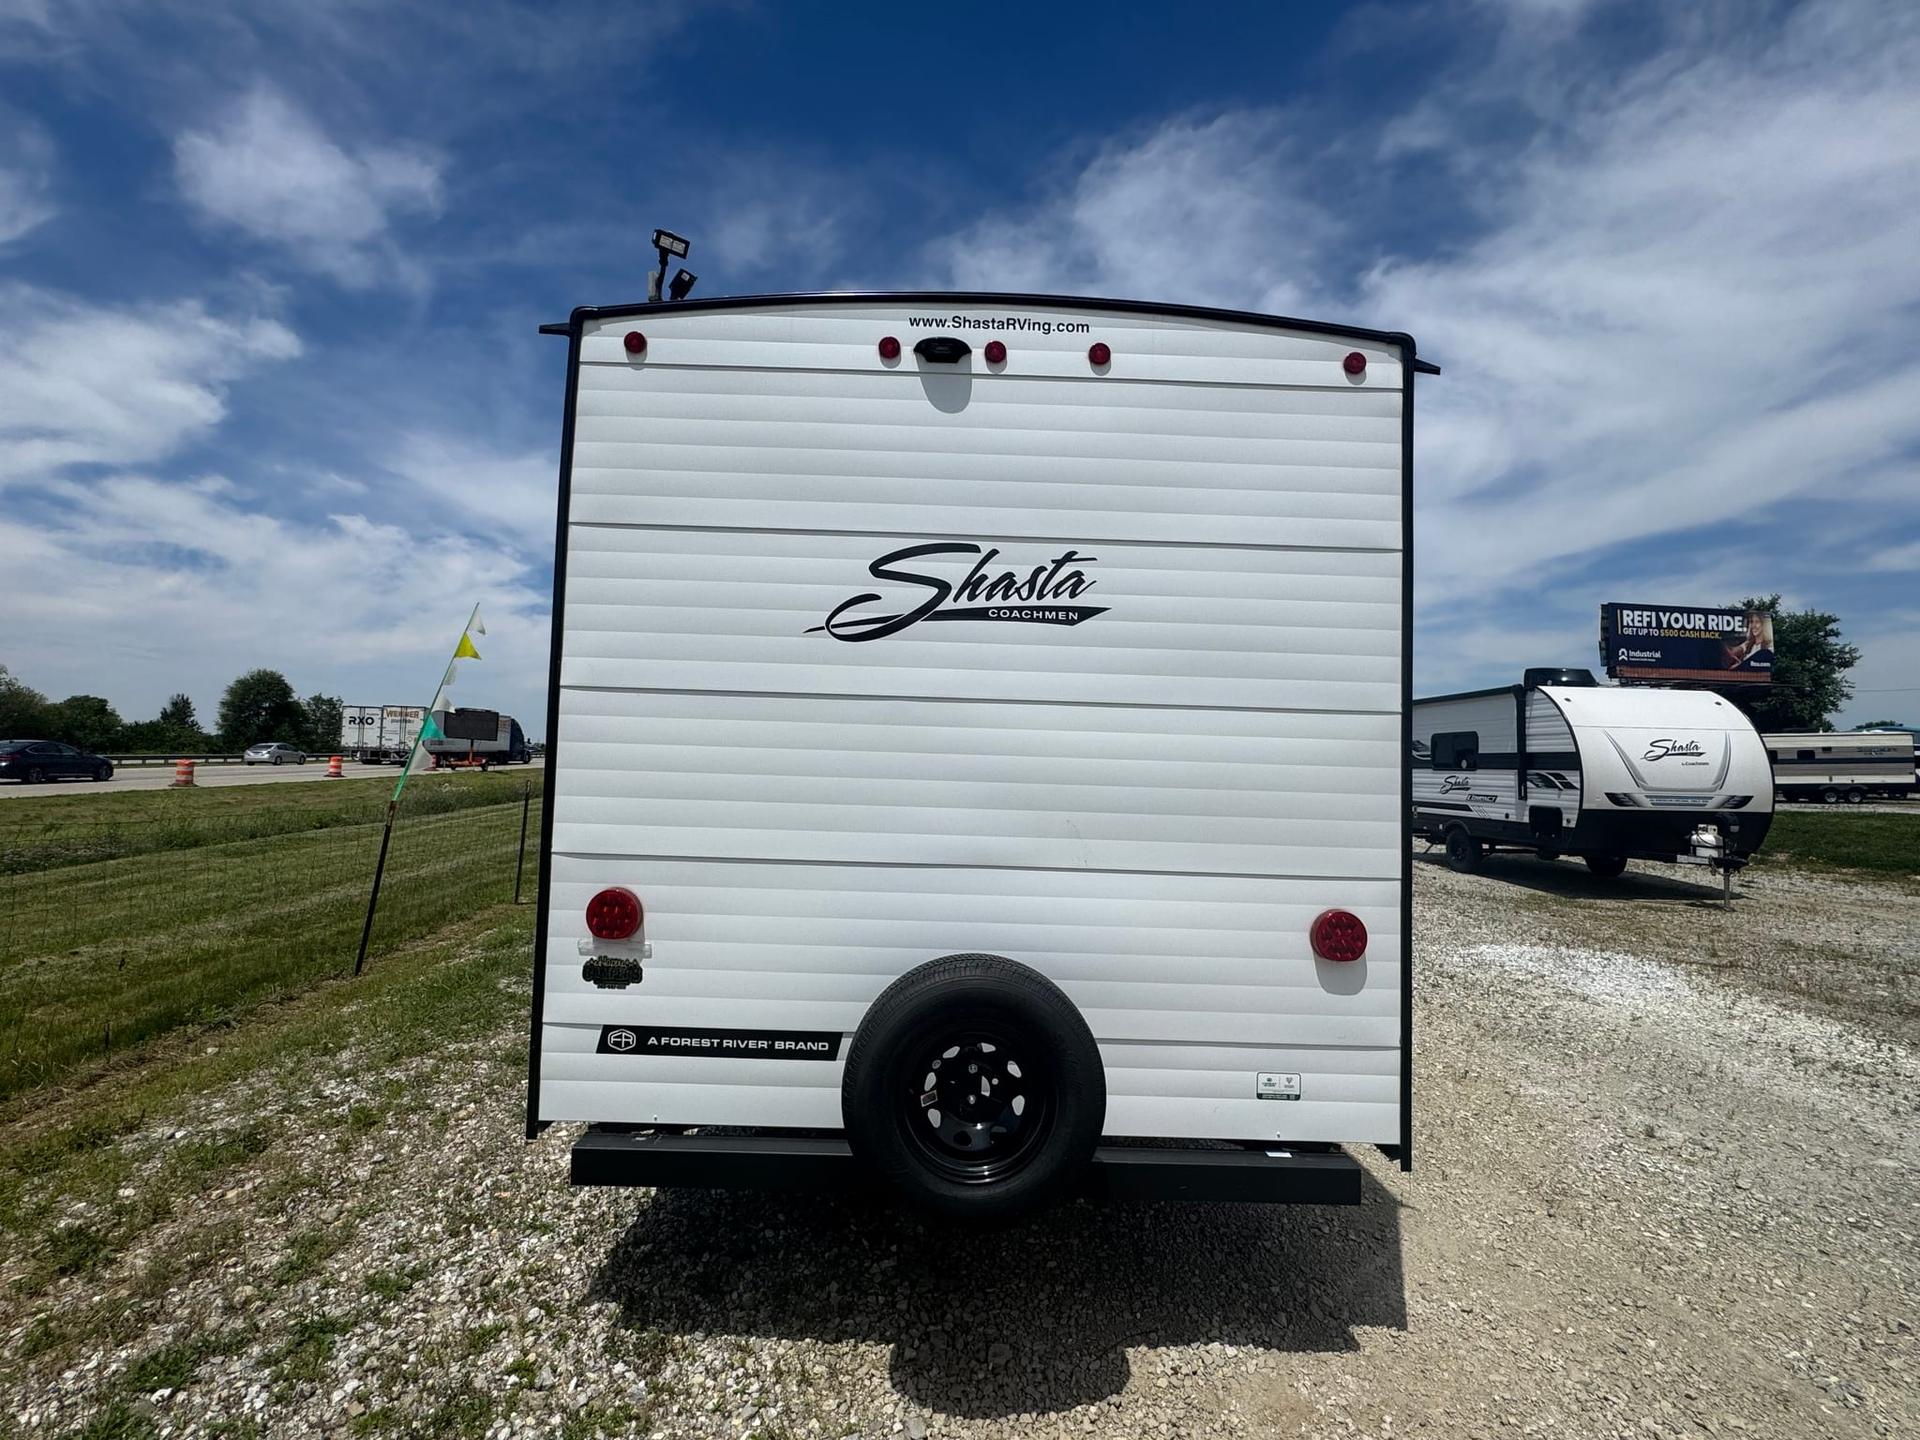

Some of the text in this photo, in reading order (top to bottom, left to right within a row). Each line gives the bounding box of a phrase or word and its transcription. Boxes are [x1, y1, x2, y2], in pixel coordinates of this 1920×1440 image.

[909, 316, 1090, 334] www.ShastaRVing.com
[825, 542, 1098, 642] Shasta
[988, 608, 1078, 621] COACHMEN
[1622, 610, 1747, 632] REFI YOUR RIDE.
[1622, 627, 1637, 635] GET
[1638, 628, 1648, 636] UP
[1629, 650, 1661, 658] Industrial
[349, 716, 375, 726] RXO
[1644, 738, 1702, 762] Shasta
[647, 1036, 829, 1051] A FOREST RIVER BRAND
